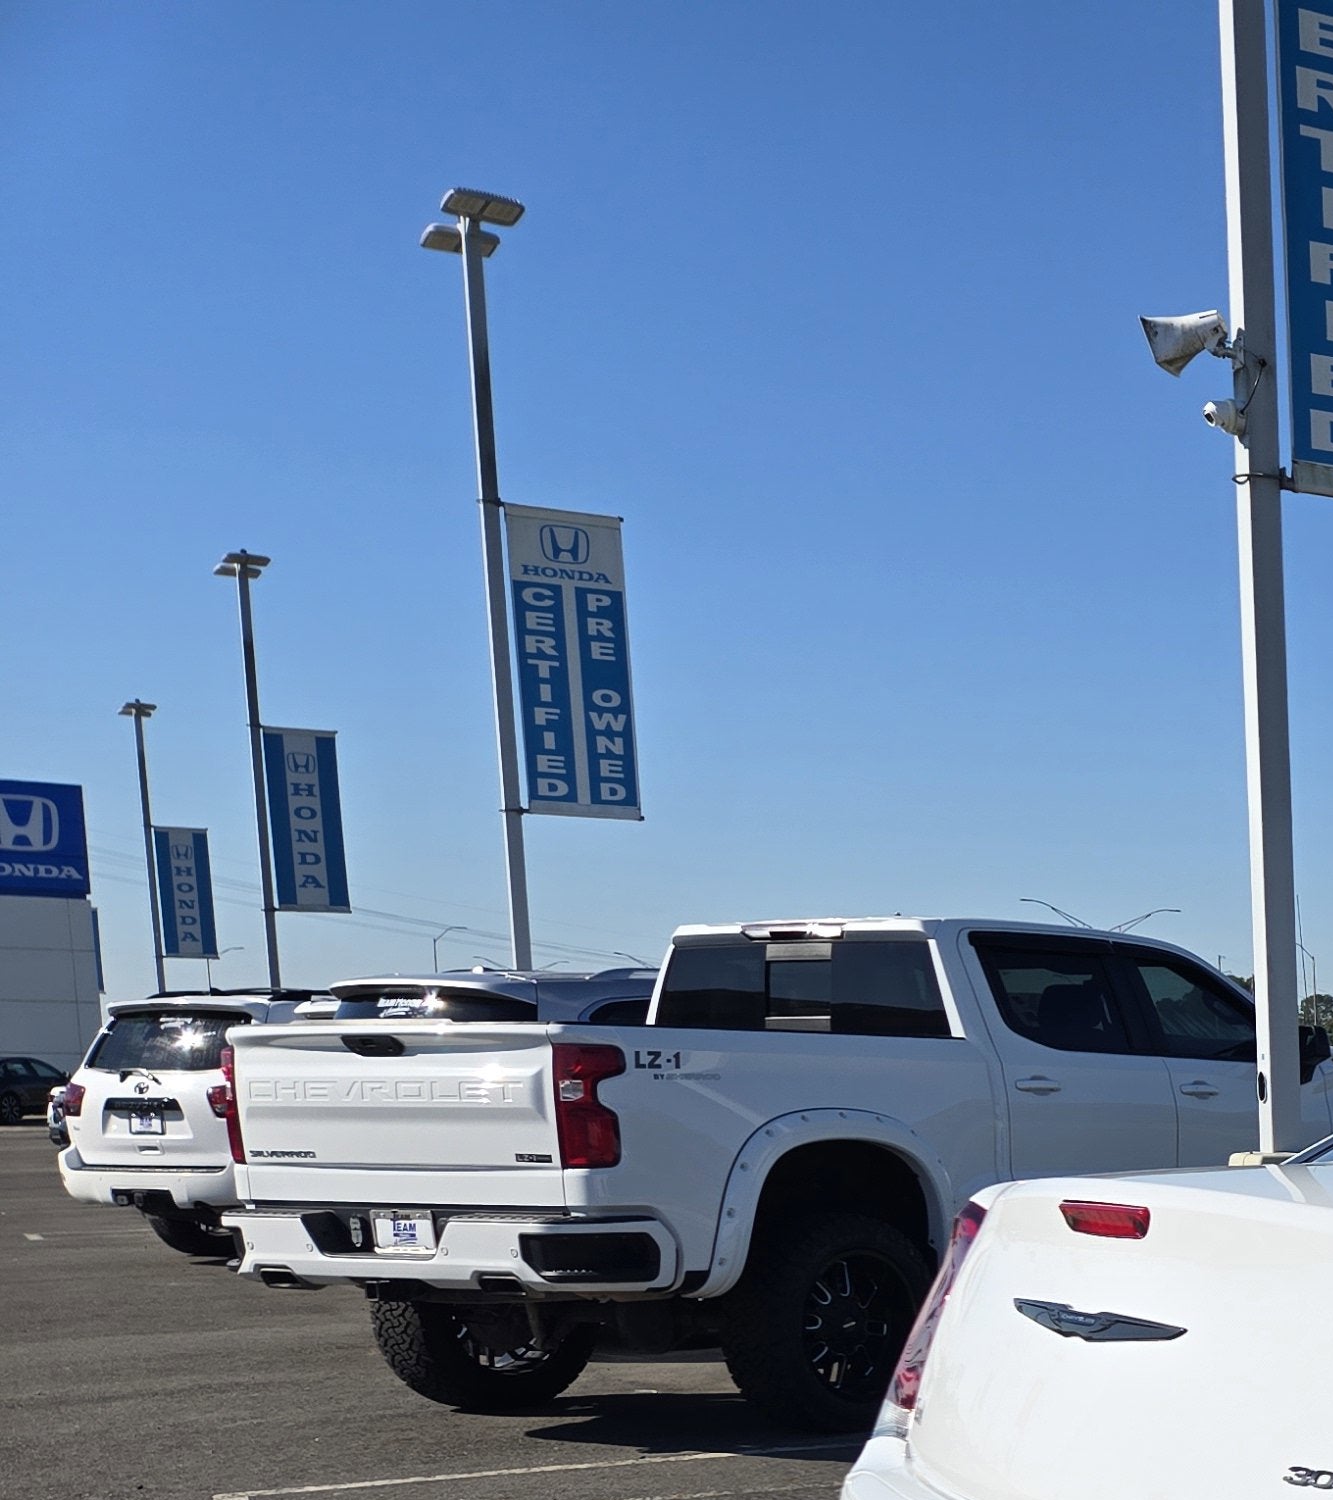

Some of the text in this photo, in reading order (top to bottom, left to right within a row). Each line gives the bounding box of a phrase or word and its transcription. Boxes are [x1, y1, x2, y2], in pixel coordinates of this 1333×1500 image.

[521, 564, 613, 585] HONDA
[521, 587, 570, 797] CERTIFIED
[587, 593, 627, 801] PRE OWNED
[290, 782, 326, 889] HONDA
[0, 862, 83, 880] ONDA
[174, 866, 200, 942] HONDA
[248, 1080, 524, 1103] CHEVROLET
[249, 1150, 317, 1159] SILVERADO
[390, 1218, 417, 1232] TEAM
